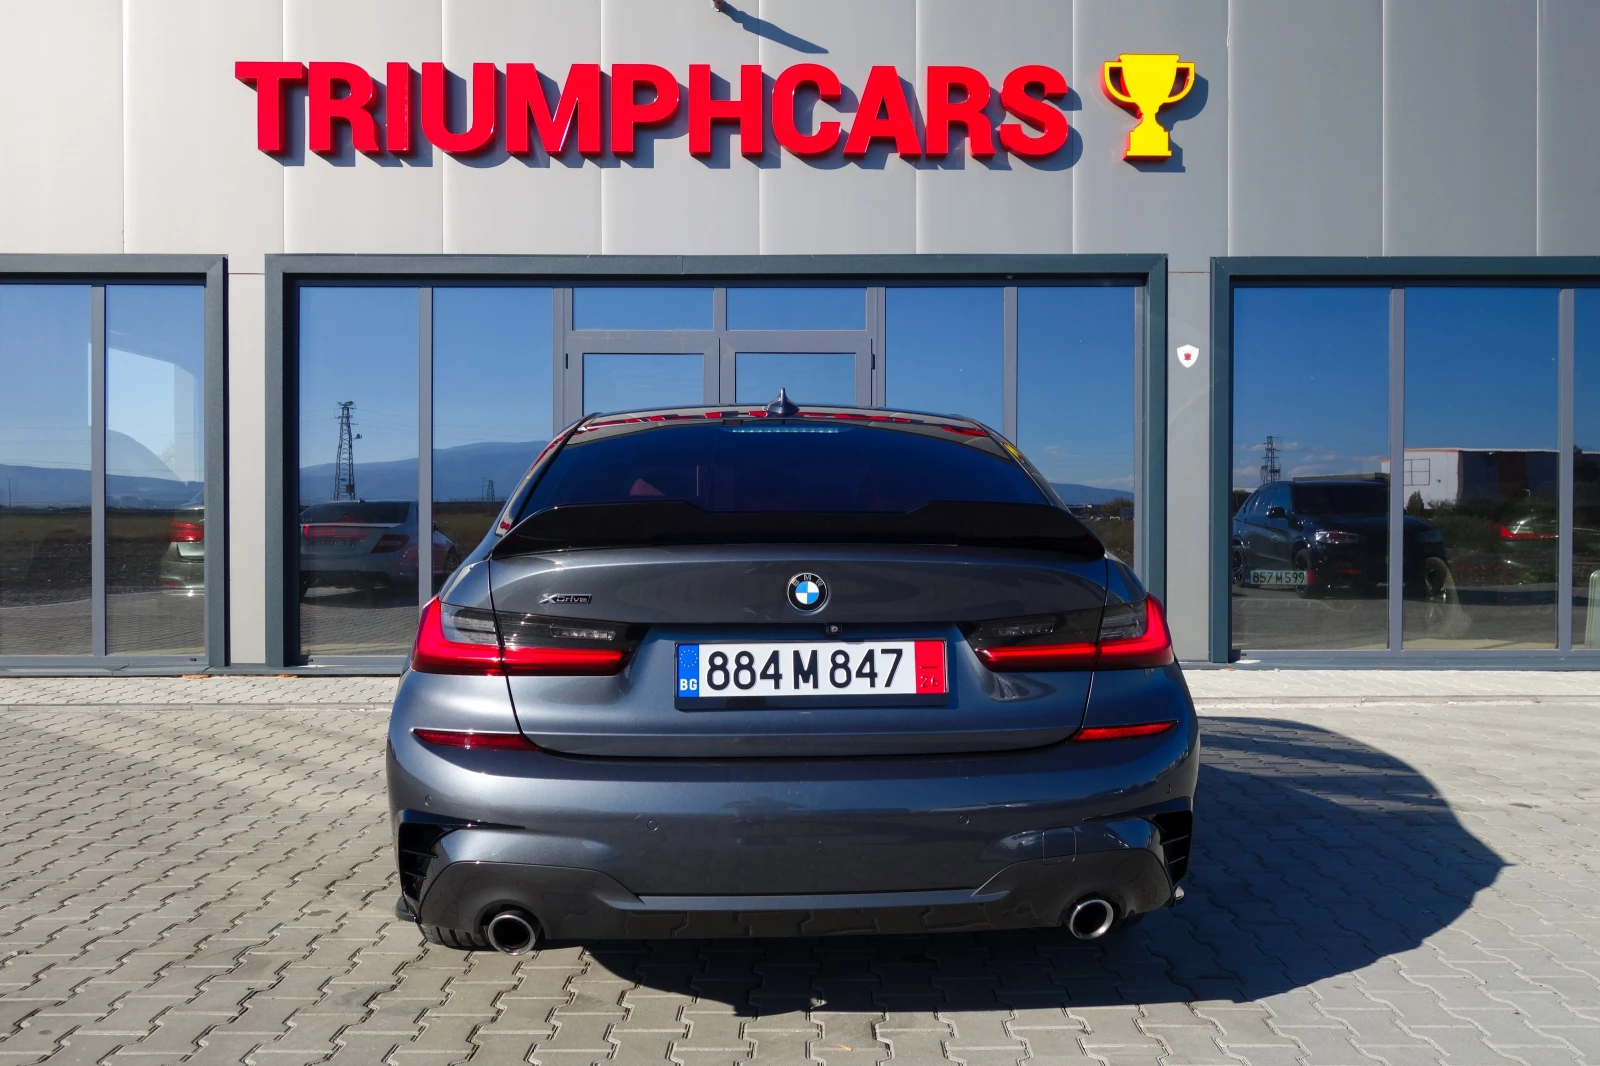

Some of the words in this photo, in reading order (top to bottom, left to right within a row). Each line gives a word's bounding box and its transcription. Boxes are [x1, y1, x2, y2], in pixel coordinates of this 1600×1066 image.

[235, 61, 1069, 159] TRIUMPHCARS
[791, 574, 824, 587] BMW
[1252, 571, 1274, 584] 857
[1275, 571, 1283, 584] M
[1284, 571, 1306, 584] 599
[706, 650, 783, 691] 884
[793, 649, 819, 690] M
[829, 648, 904, 689] 847
[679, 678, 698, 691] BG
[920, 675, 940, 688] 26
